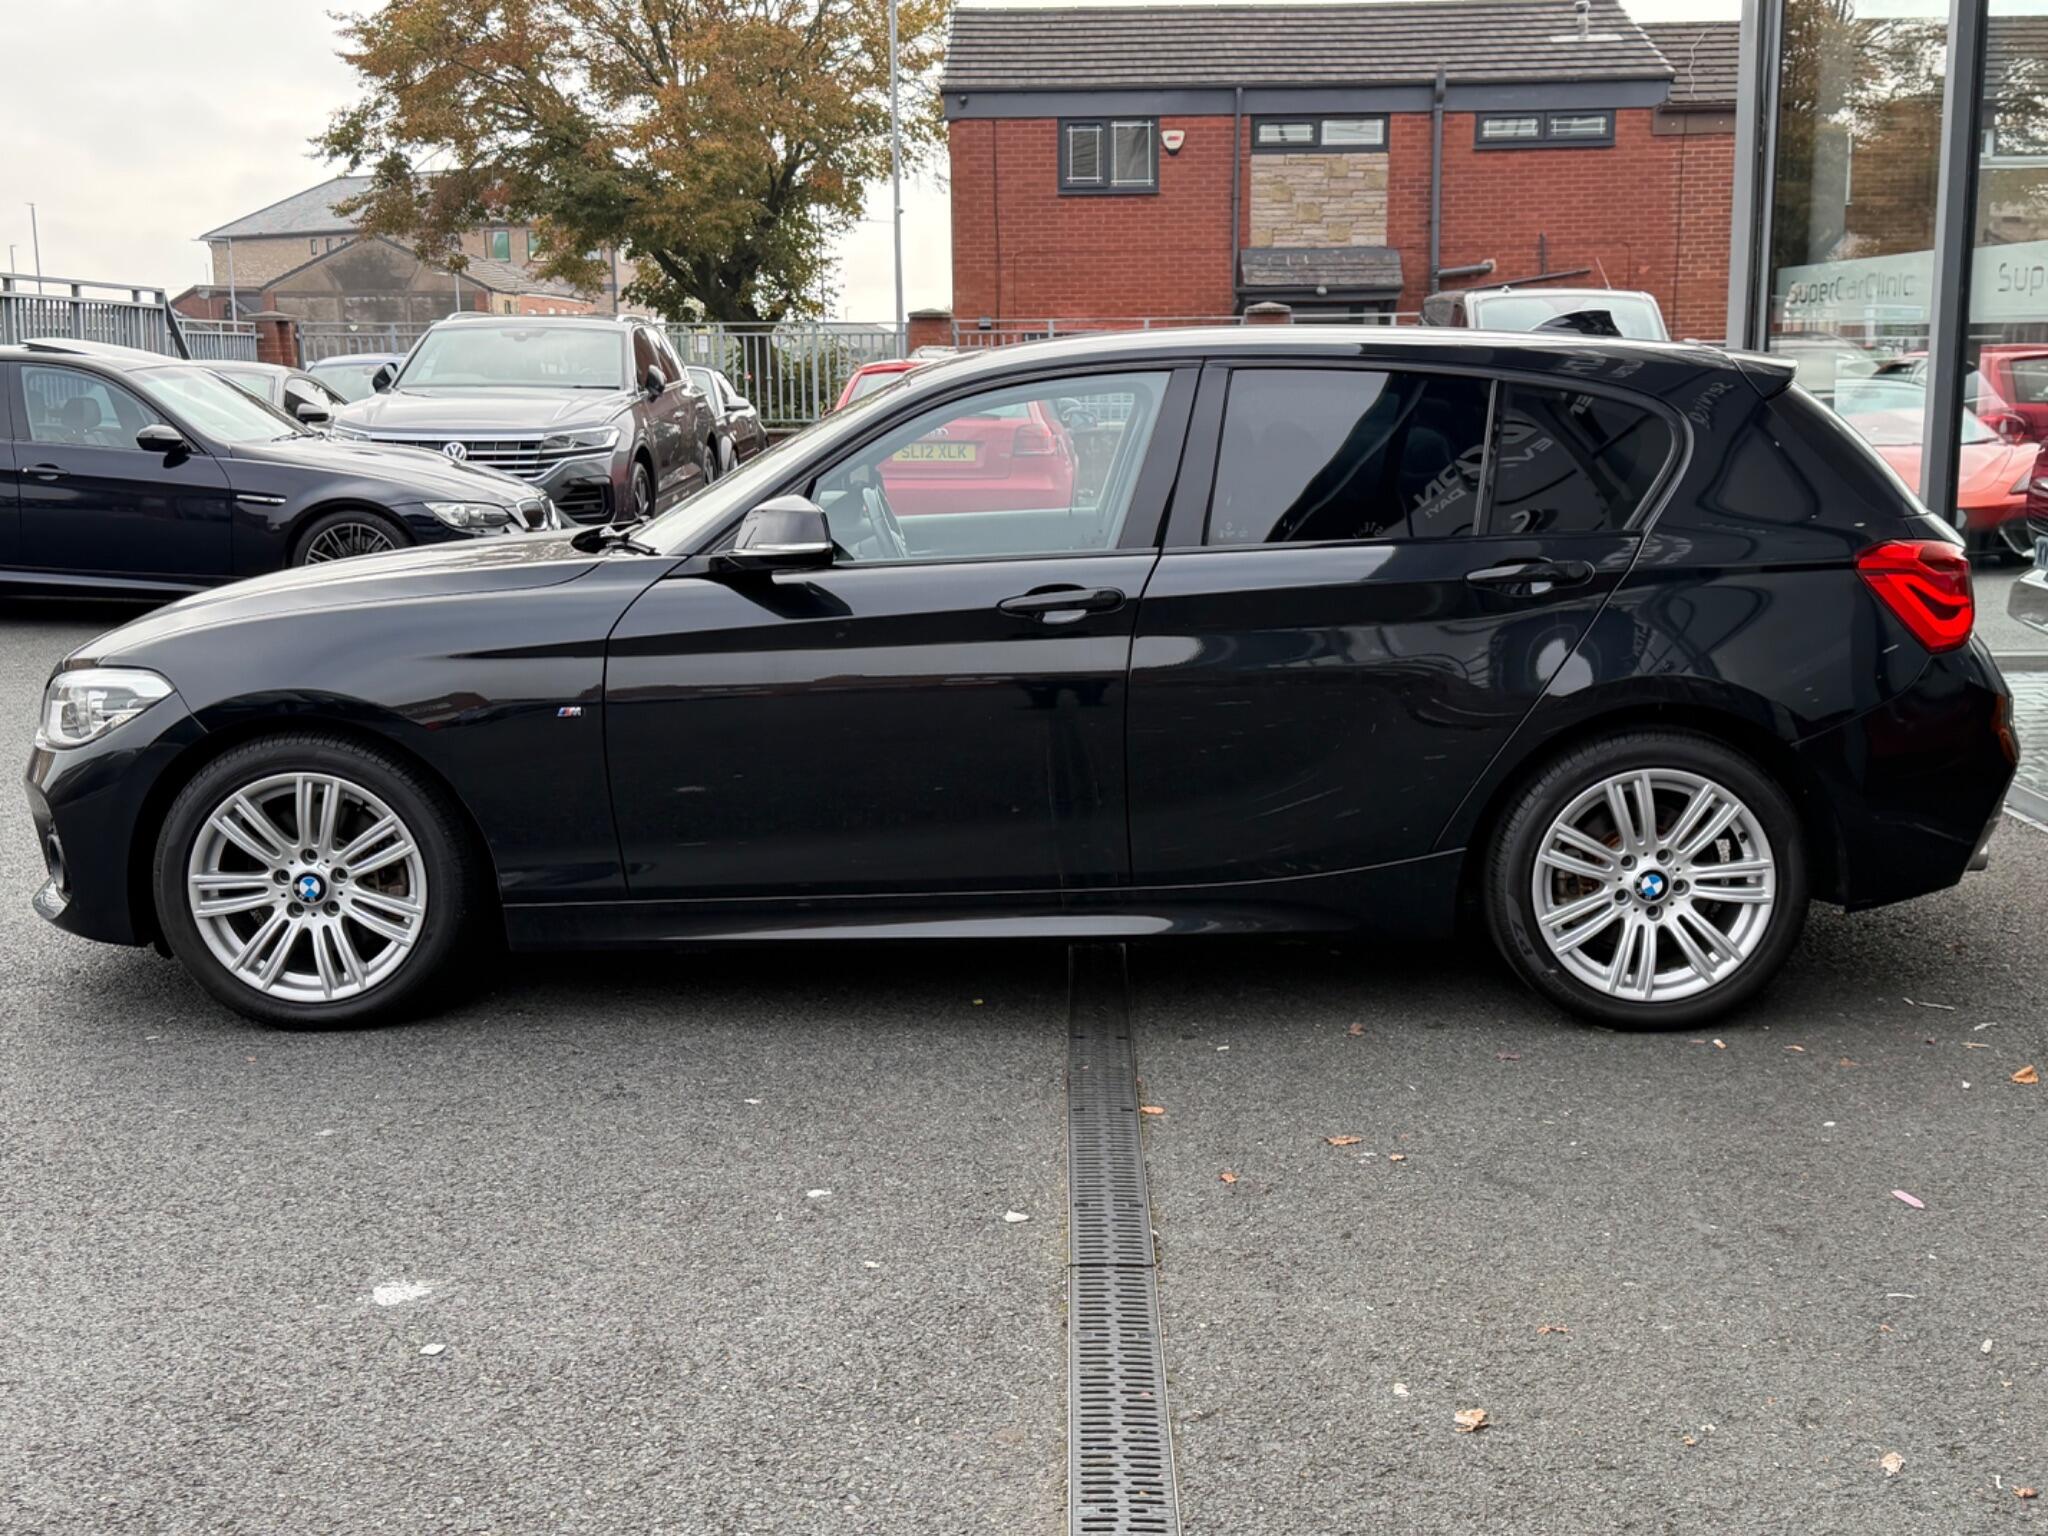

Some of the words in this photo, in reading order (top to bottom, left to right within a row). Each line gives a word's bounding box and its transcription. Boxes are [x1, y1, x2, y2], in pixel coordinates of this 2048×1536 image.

[1788, 272, 1916, 306] SuperCarClinic
[1997, 262, 2048, 297] Sup
[901, 445, 935, 459] SL12
[939, 445, 967, 459] XLK
